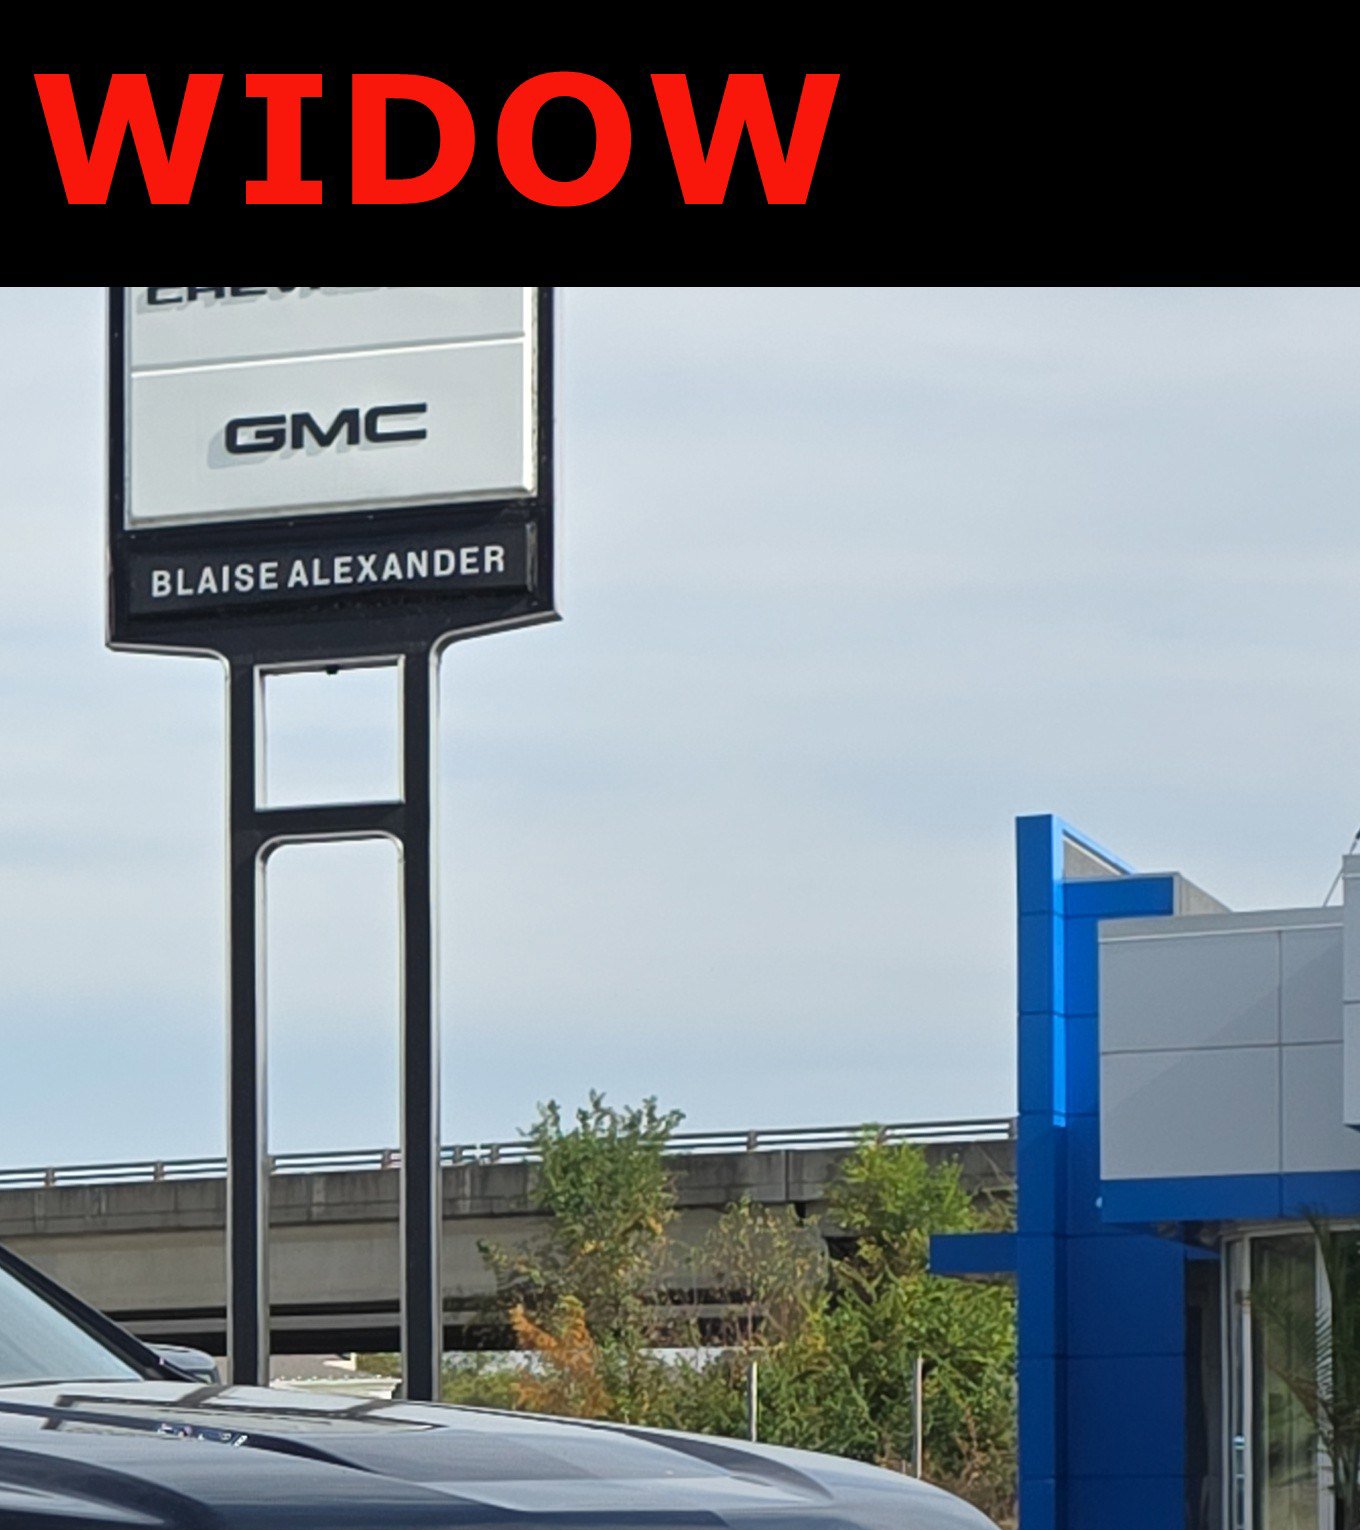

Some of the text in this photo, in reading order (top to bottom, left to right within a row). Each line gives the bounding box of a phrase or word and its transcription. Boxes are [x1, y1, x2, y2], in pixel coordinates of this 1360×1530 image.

[224, 402, 427, 454] GMC
[152, 545, 505, 598] BLAISE ALEXANDER
